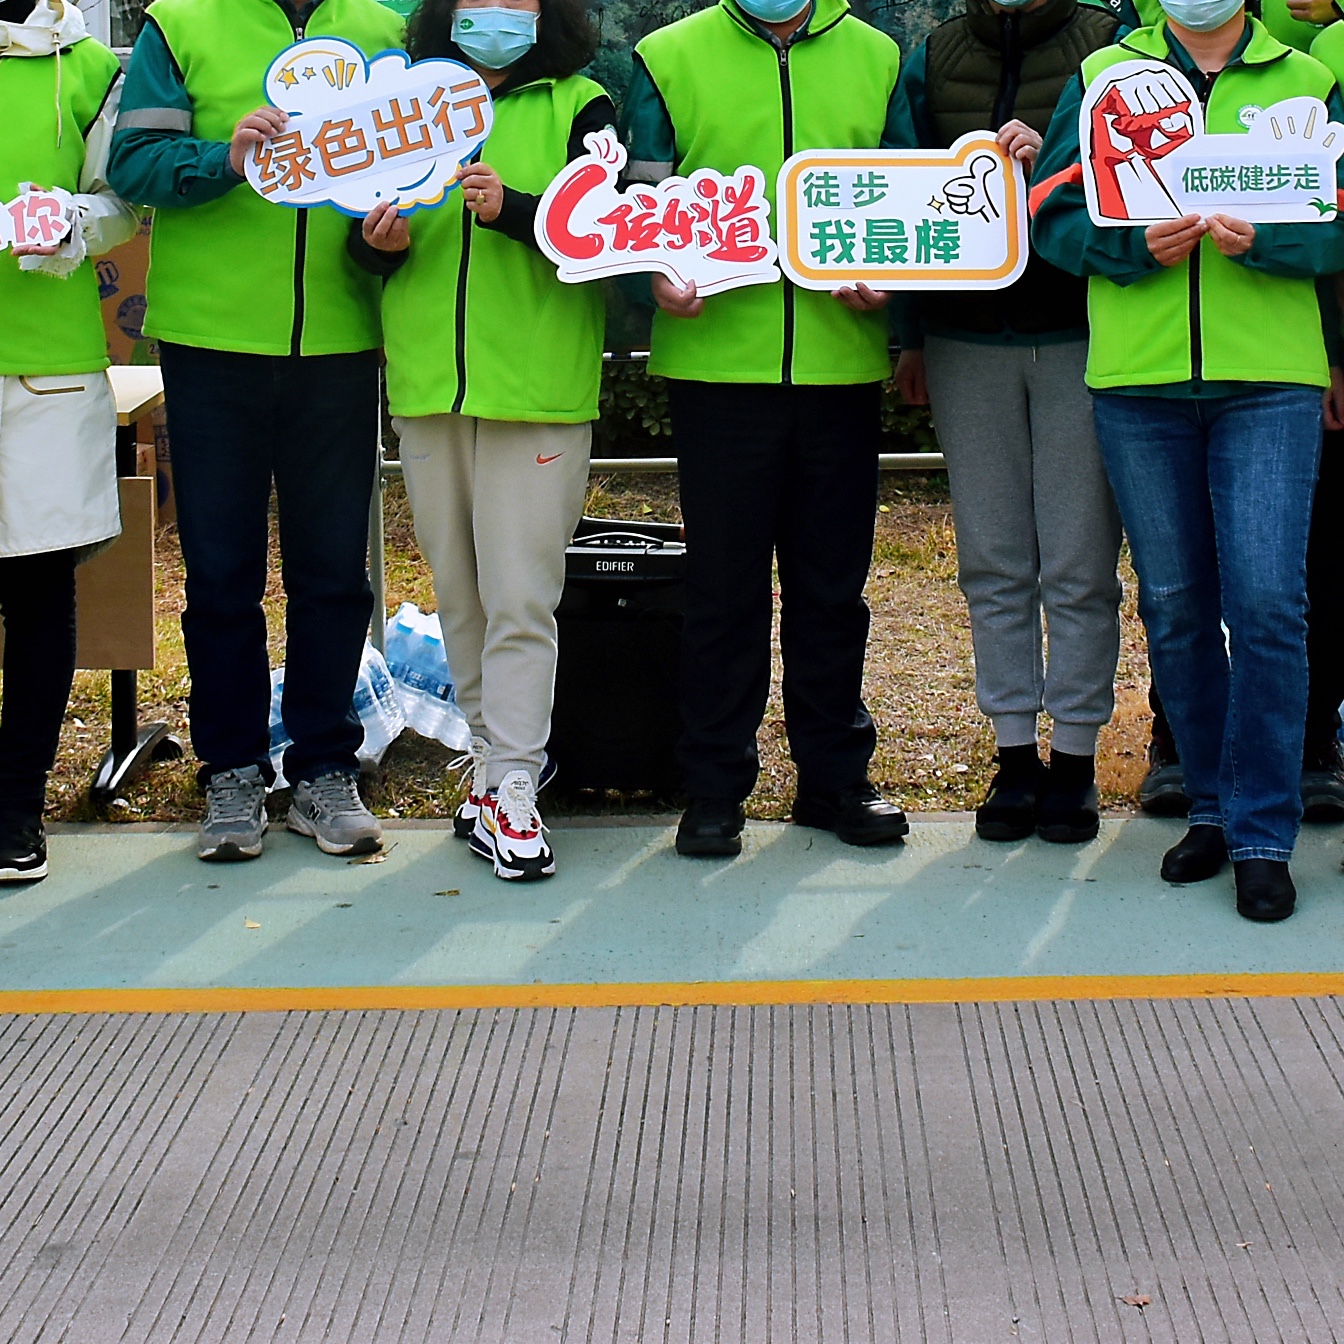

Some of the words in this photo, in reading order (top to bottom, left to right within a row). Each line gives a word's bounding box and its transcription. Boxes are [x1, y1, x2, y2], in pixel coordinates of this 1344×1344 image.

[253, 78, 488, 195] 绿色出行
[803, 171, 890, 209] 徒步
[1182, 164, 1321, 193] 低碳健步走
[809, 218, 962, 265] 我最棒
[596, 561, 635, 572] EDIFIER
